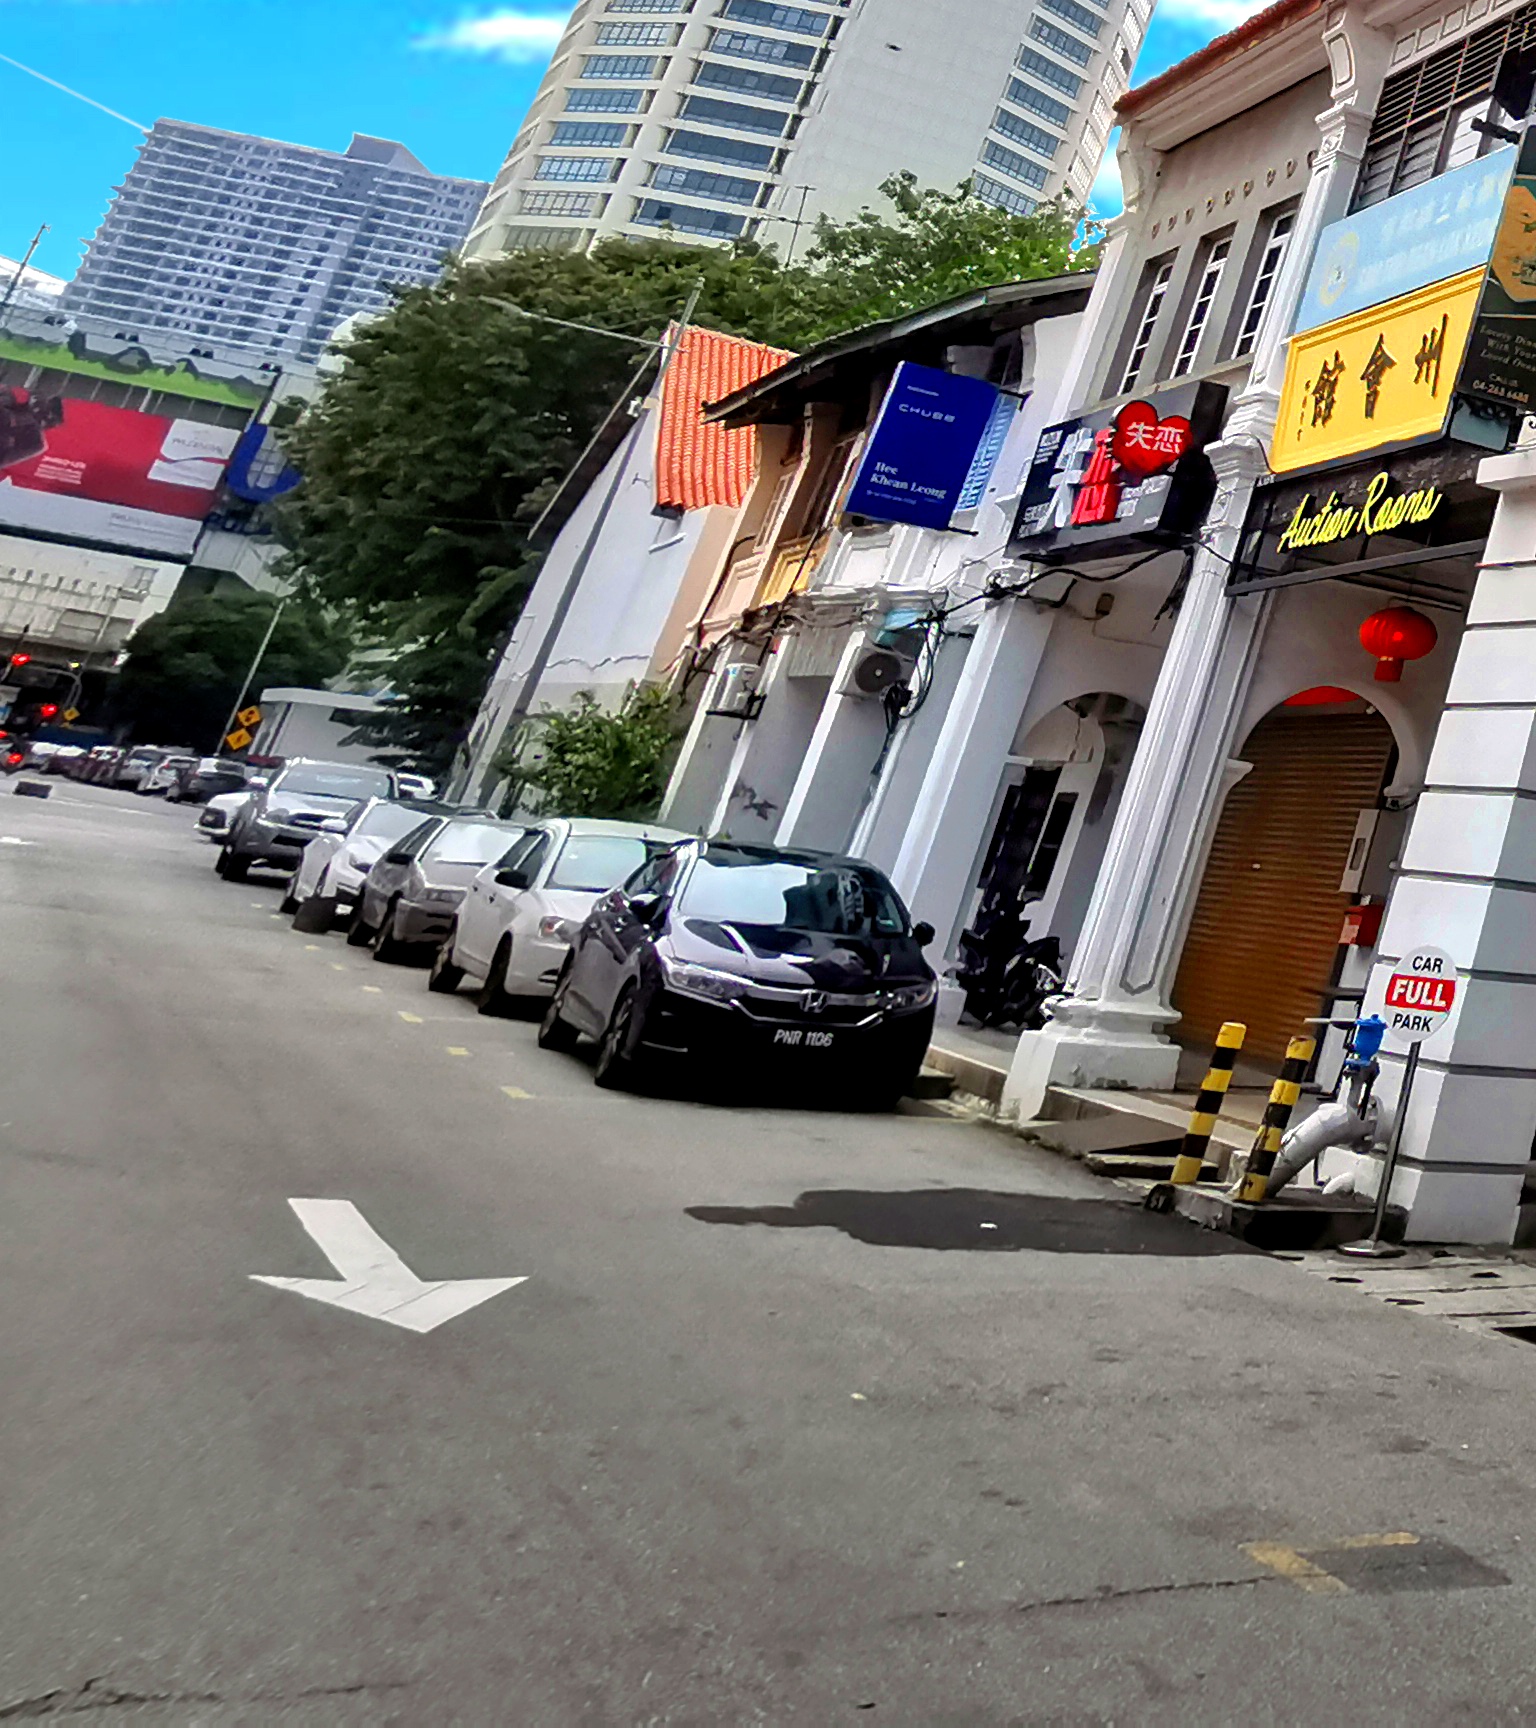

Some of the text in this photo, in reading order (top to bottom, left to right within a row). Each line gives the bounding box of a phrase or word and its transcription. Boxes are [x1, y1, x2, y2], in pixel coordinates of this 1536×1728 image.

[1125, 421, 1185, 454] 失恋
[1277, 472, 1442, 553] Auction Rooms
[1412, 955, 1443, 973] CAR
[1391, 978, 1446, 1007] FULL
[1392, 1013, 1433, 1032] PARK
[773, 1028, 803, 1045] PNR
